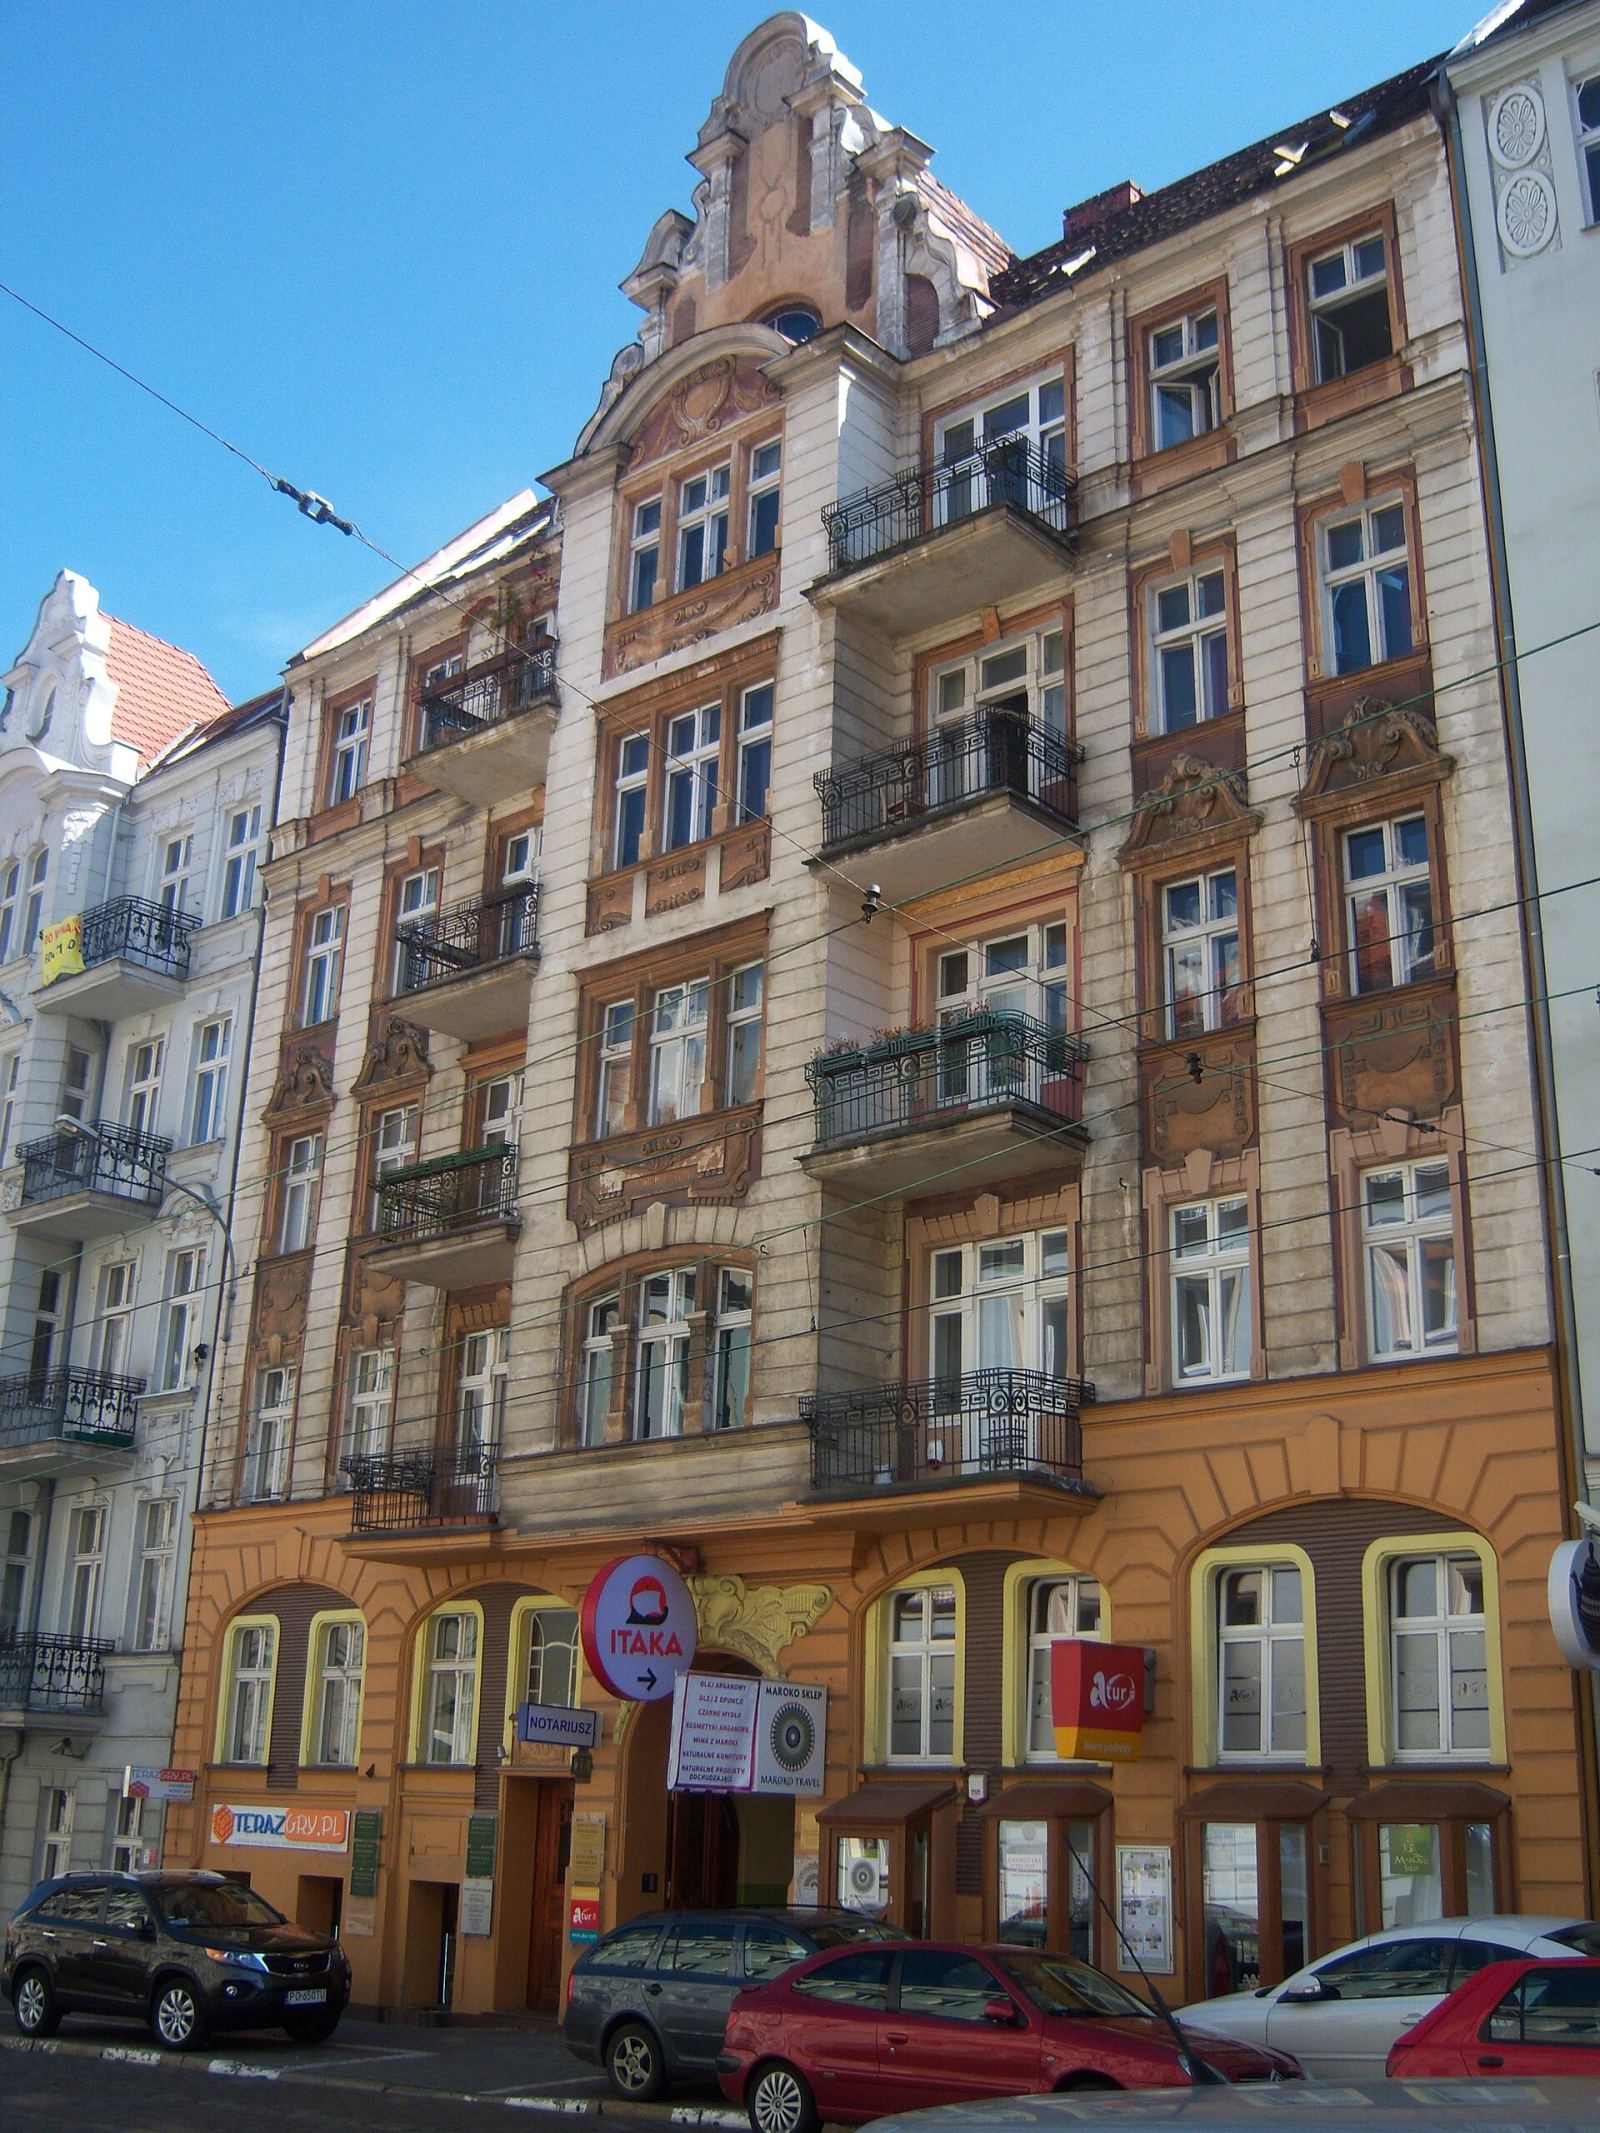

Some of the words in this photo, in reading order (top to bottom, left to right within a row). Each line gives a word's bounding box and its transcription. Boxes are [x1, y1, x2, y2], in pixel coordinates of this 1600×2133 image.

[610, 1629, 684, 1656] ITAKA
[765, 1686, 800, 1697] MAROKO
[801, 1689, 823, 1700] SKLEP
[529, 1716, 592, 1735] NOTARIUSZ
[761, 1775, 795, 1786] MAROKO
[795, 1777, 821, 1787] TRAVEL
